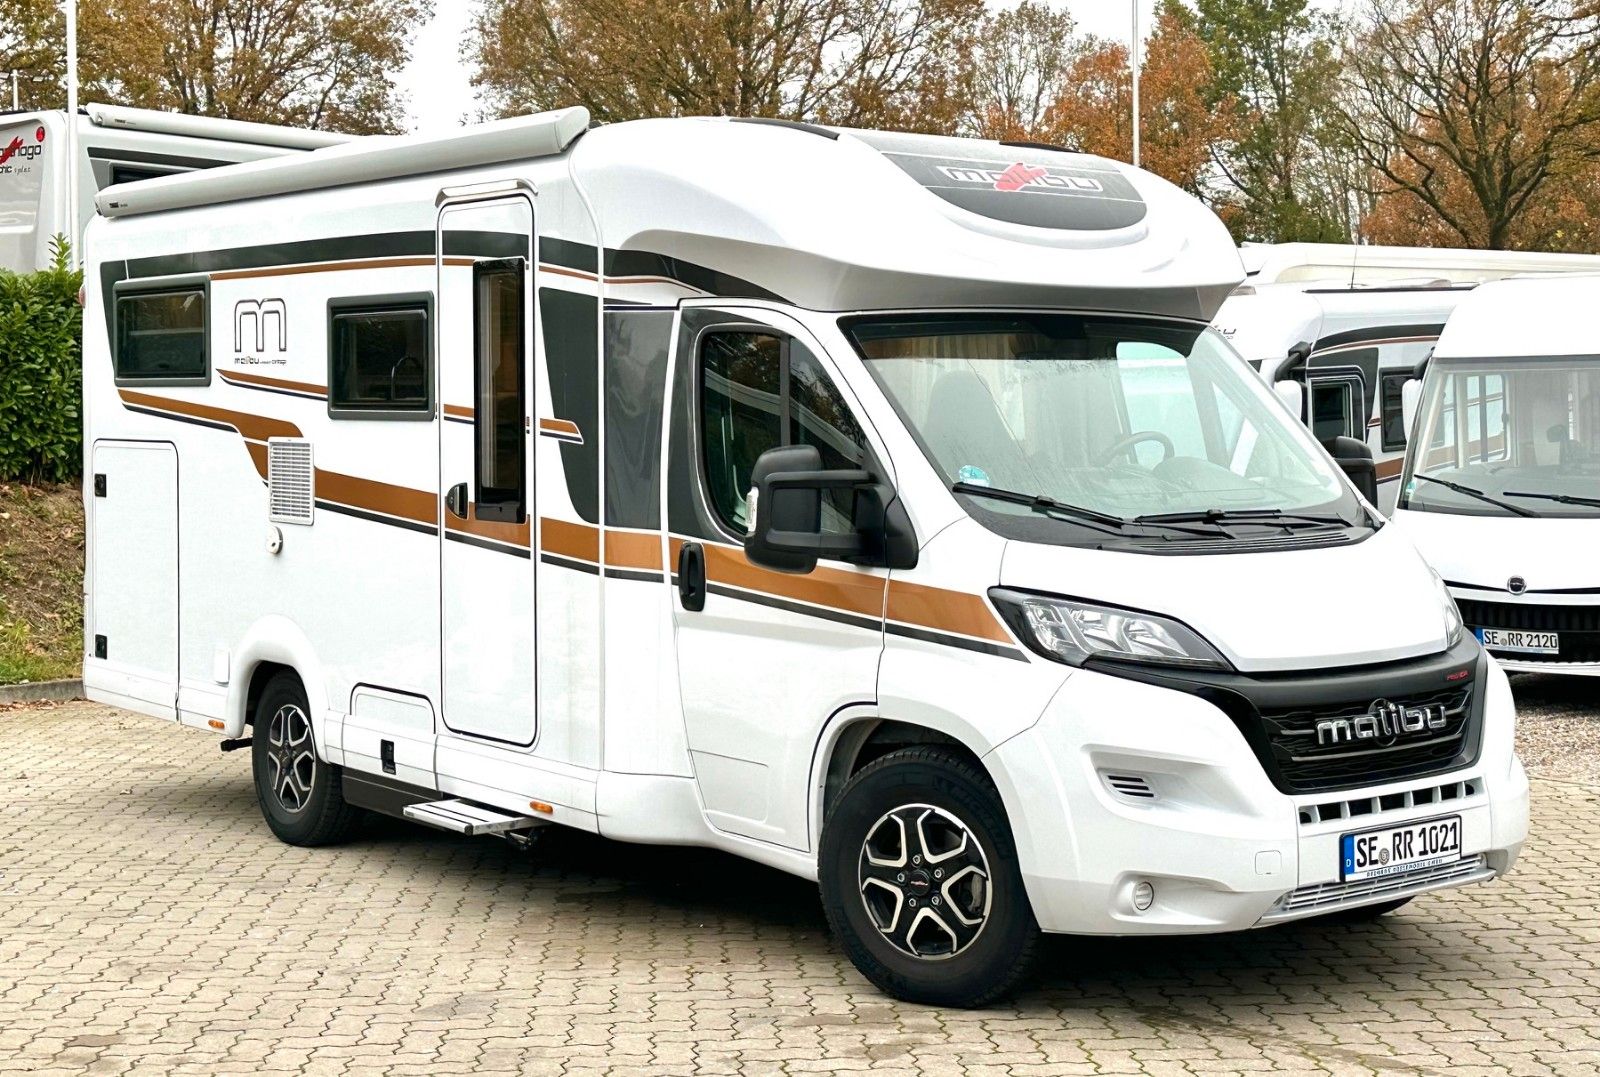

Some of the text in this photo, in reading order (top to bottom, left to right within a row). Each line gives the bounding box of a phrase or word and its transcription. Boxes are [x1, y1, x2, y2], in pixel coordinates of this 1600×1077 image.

[936, 165, 1103, 192] malibu
[1484, 631, 1558, 648] SE RR 2120
[1316, 704, 1447, 745] malibu
[1356, 821, 1459, 868] SE RR 1021
